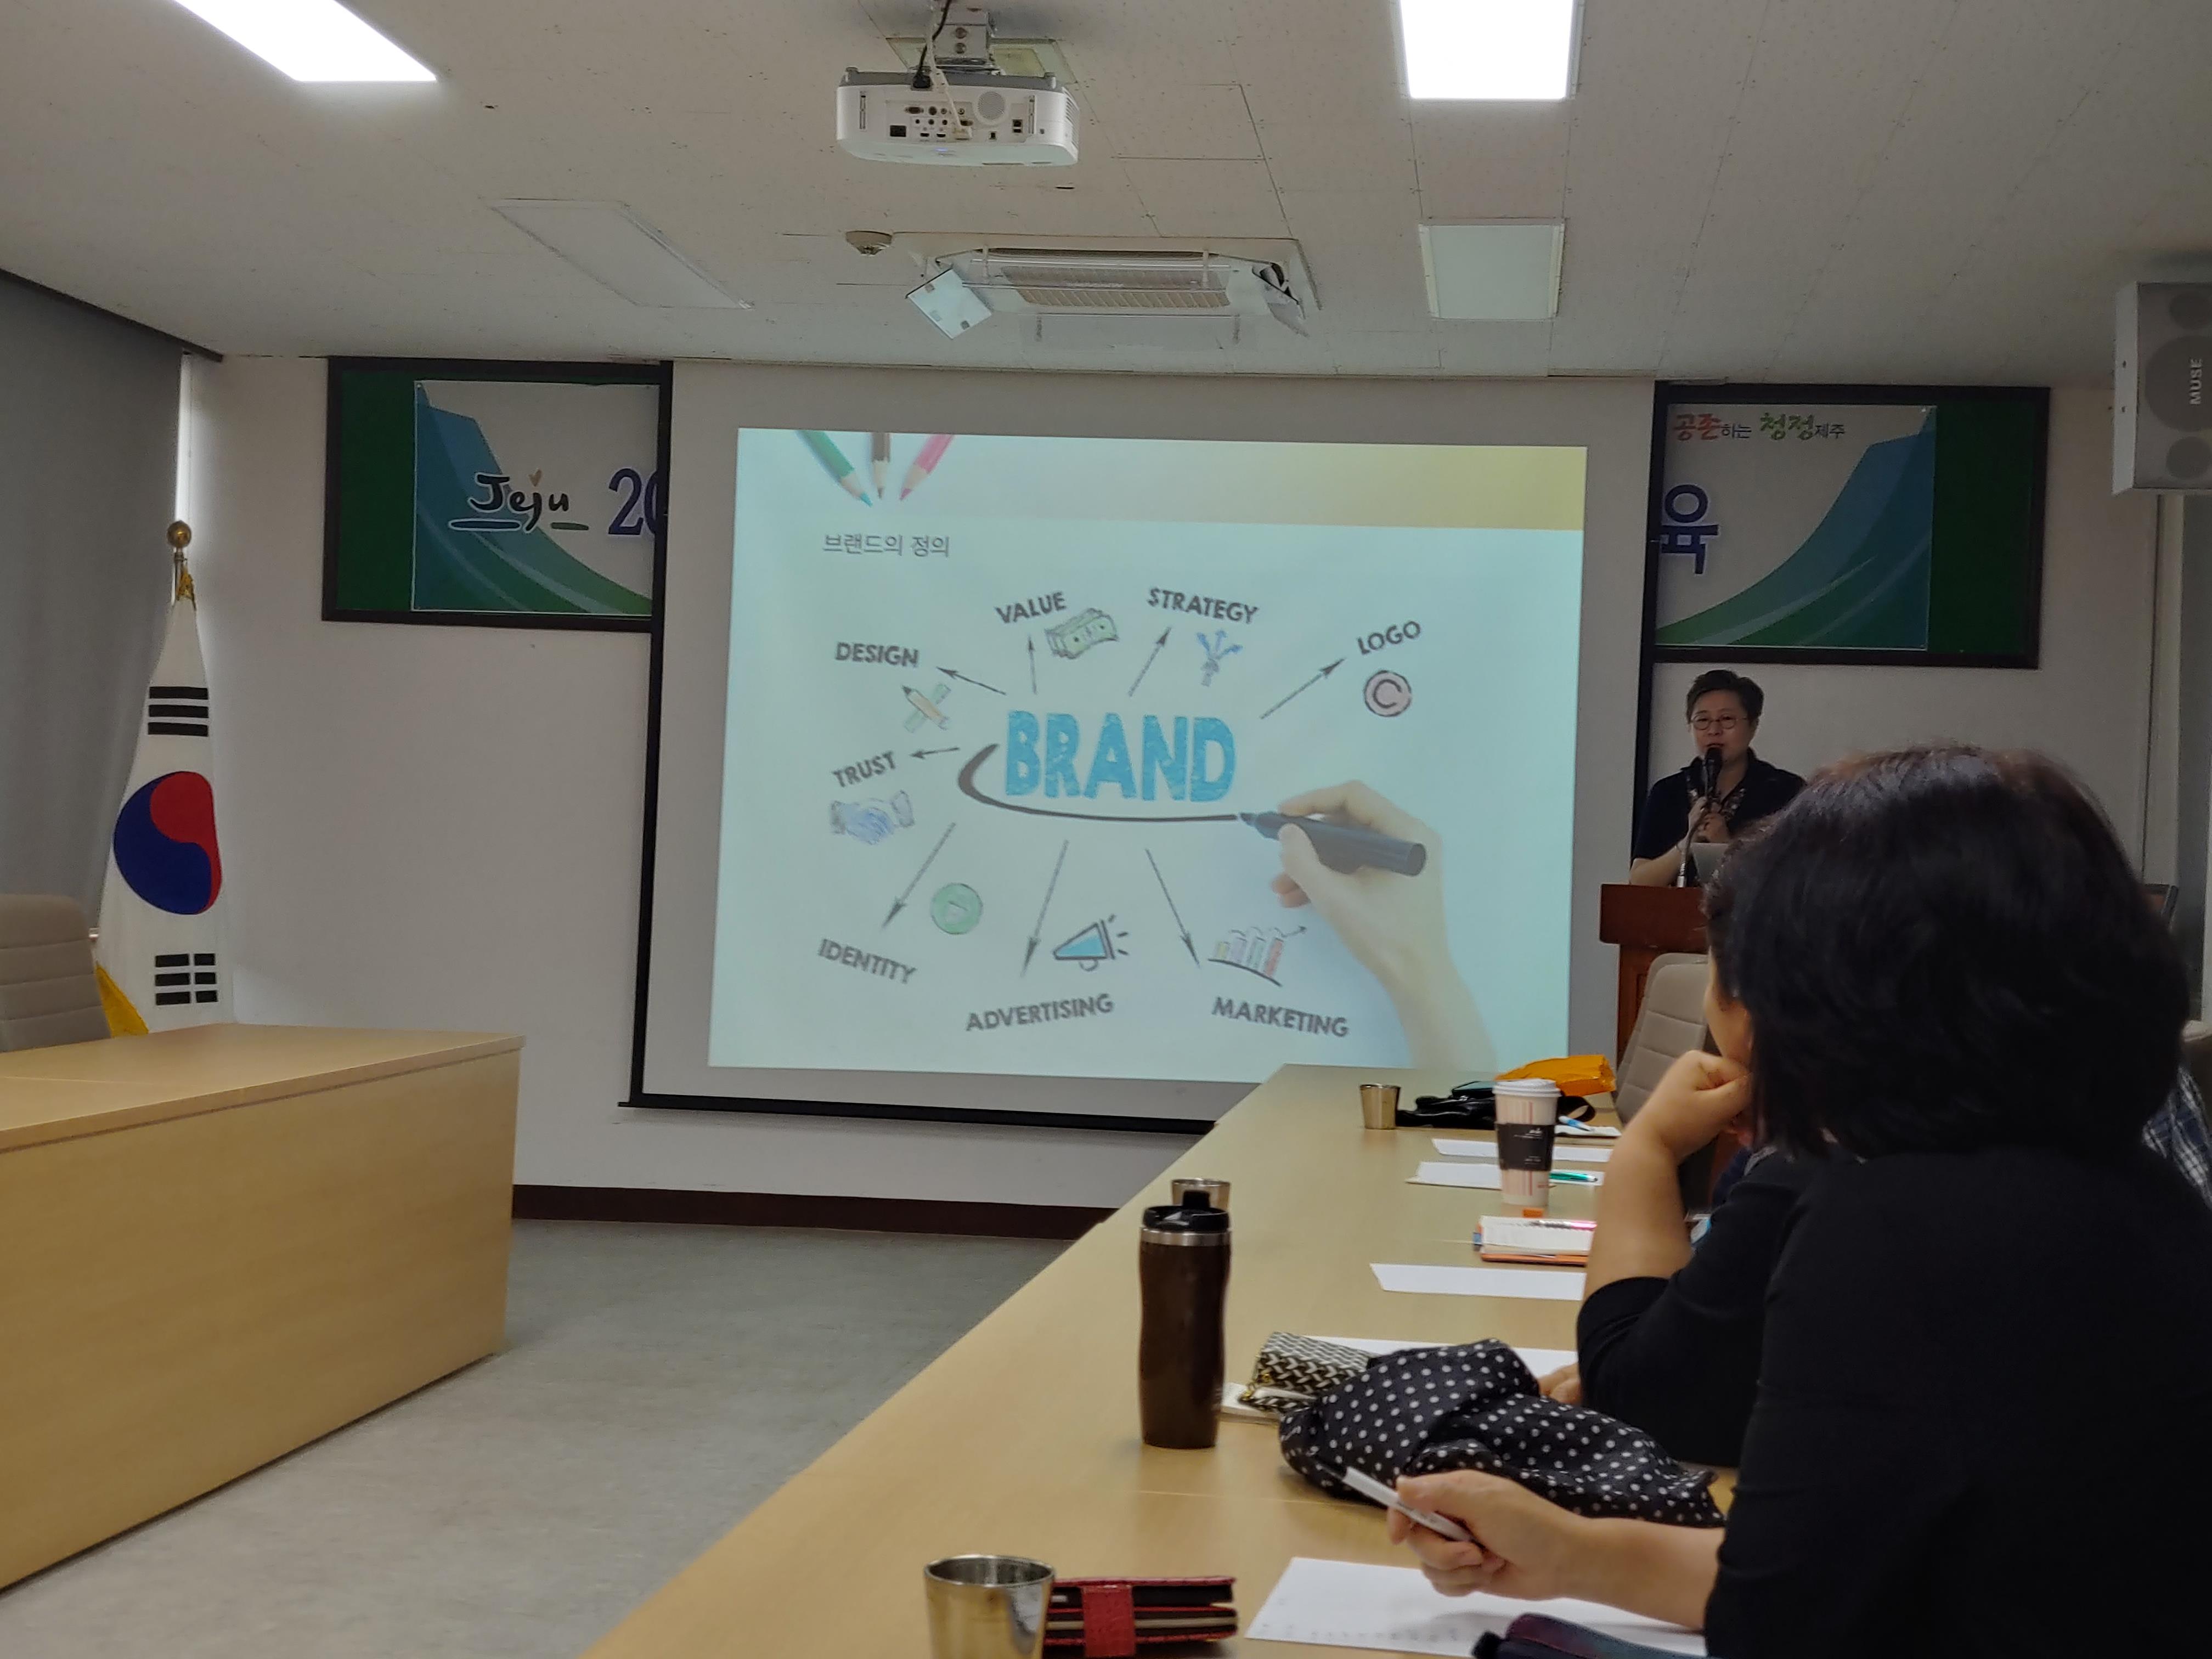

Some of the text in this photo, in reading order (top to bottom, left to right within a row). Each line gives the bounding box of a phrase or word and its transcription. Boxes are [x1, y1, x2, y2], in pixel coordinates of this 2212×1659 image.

[2190, 358, 2204, 405] MUSE
[1674, 412, 1846, 441] 공존하는 청정제주
[468, 469, 569, 532] Jeju
[823, 533, 950, 558] 브랜드의 정의
[1661, 483, 1719, 575] 육
[994, 591, 1068, 624] VALUE
[1147, 586, 1260, 625] STRATEGY
[834, 641, 920, 668] DESIGN
[1356, 619, 1422, 656] LOGO
[831, 751, 898, 789] TRUST
[1006, 709, 1237, 803] BRAND
[818, 938, 918, 985] IDENTITY
[966, 992, 1114, 1032] ADVERTISING
[1211, 996, 1350, 1038] MARKETING
